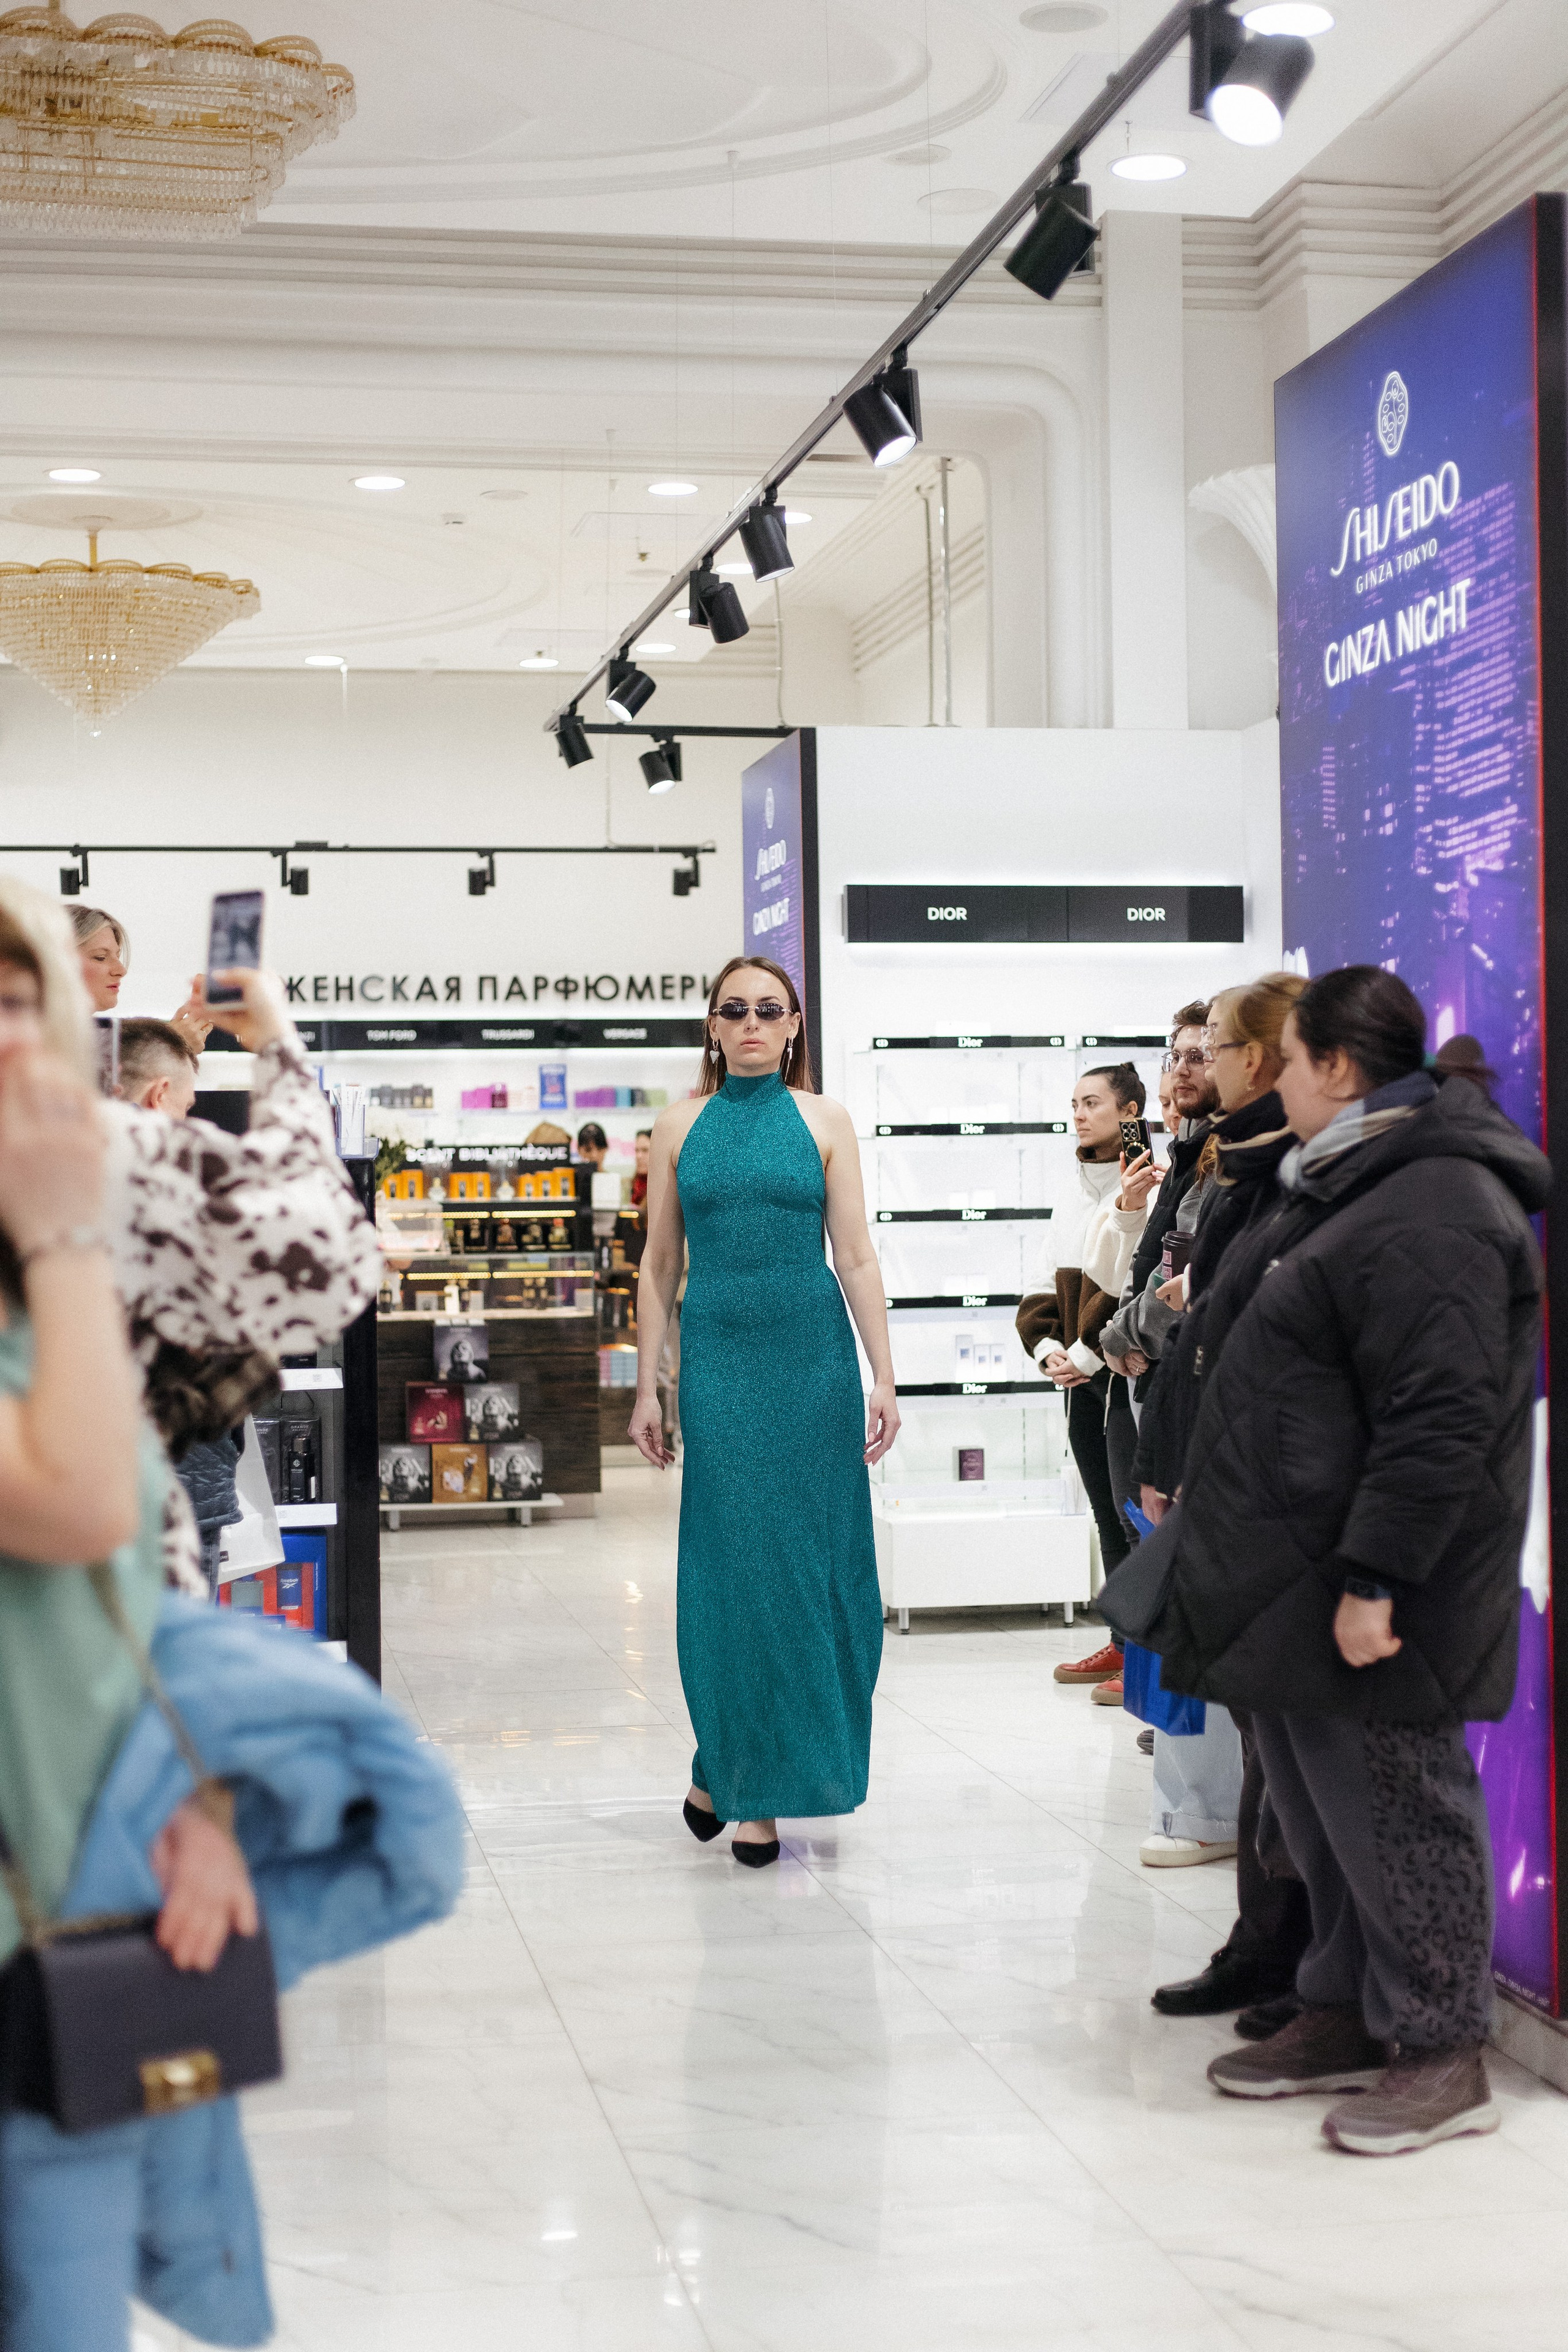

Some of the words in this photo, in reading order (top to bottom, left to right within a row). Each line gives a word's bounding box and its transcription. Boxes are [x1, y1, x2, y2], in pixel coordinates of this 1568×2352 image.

[1330, 461, 1460, 575] SHISEIDO
[1355, 565, 1393, 595] GINZA
[1396, 538, 1438, 574] TOKYO
[1324, 619, 1391, 688] GINZA
[1397, 578, 1471, 658] NIGHT
[927, 907, 968, 921] DIOR
[1126, 907, 1166, 921] DIOR
[284, 975, 461, 1001] ЖЕНСКАЯ
[958, 1037, 983, 1048] Dior
[960, 1123, 985, 1134] Dior
[962, 1210, 987, 1220] Dior
[963, 1296, 987, 1306] Dior
[963, 1384, 987, 1394] Dior
